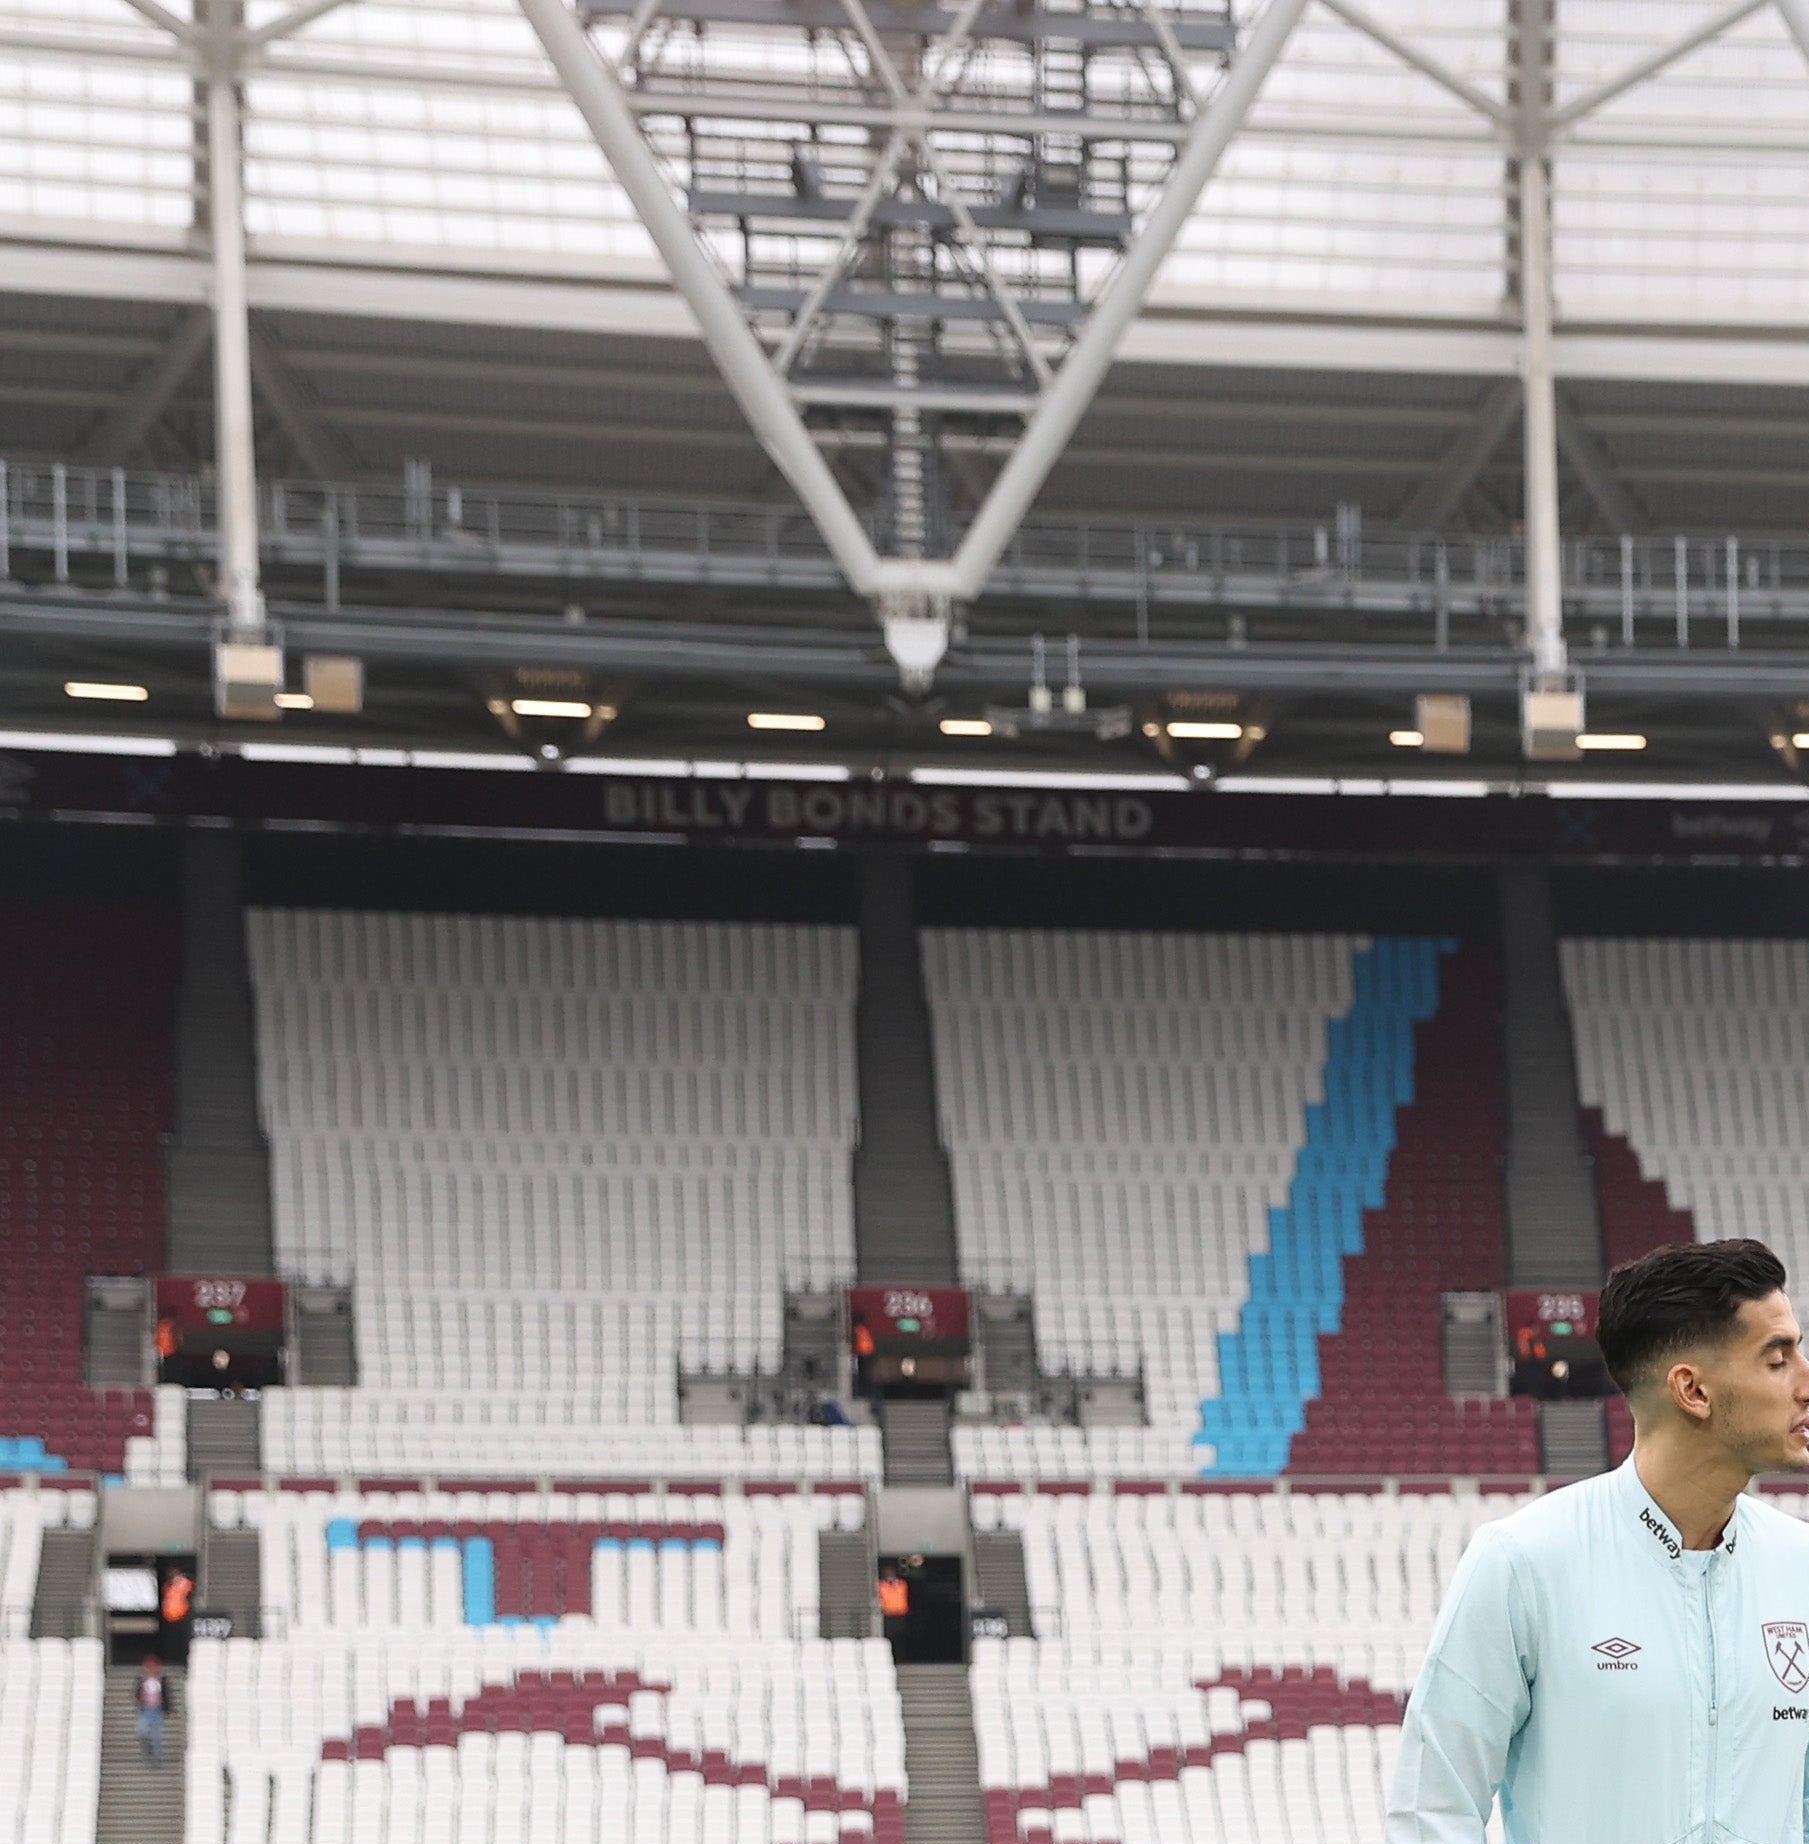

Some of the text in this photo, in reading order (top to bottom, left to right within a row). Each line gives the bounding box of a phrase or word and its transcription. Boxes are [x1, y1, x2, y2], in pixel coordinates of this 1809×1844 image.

[606, 784, 1151, 838] BILLY BONDS STAND
[193, 1280, 246, 1307] 237
[1639, 1508, 1681, 1560] betway
[1767, 1626, 1784, 1635] WEST
[1597, 1660, 1638, 1671] umbro
